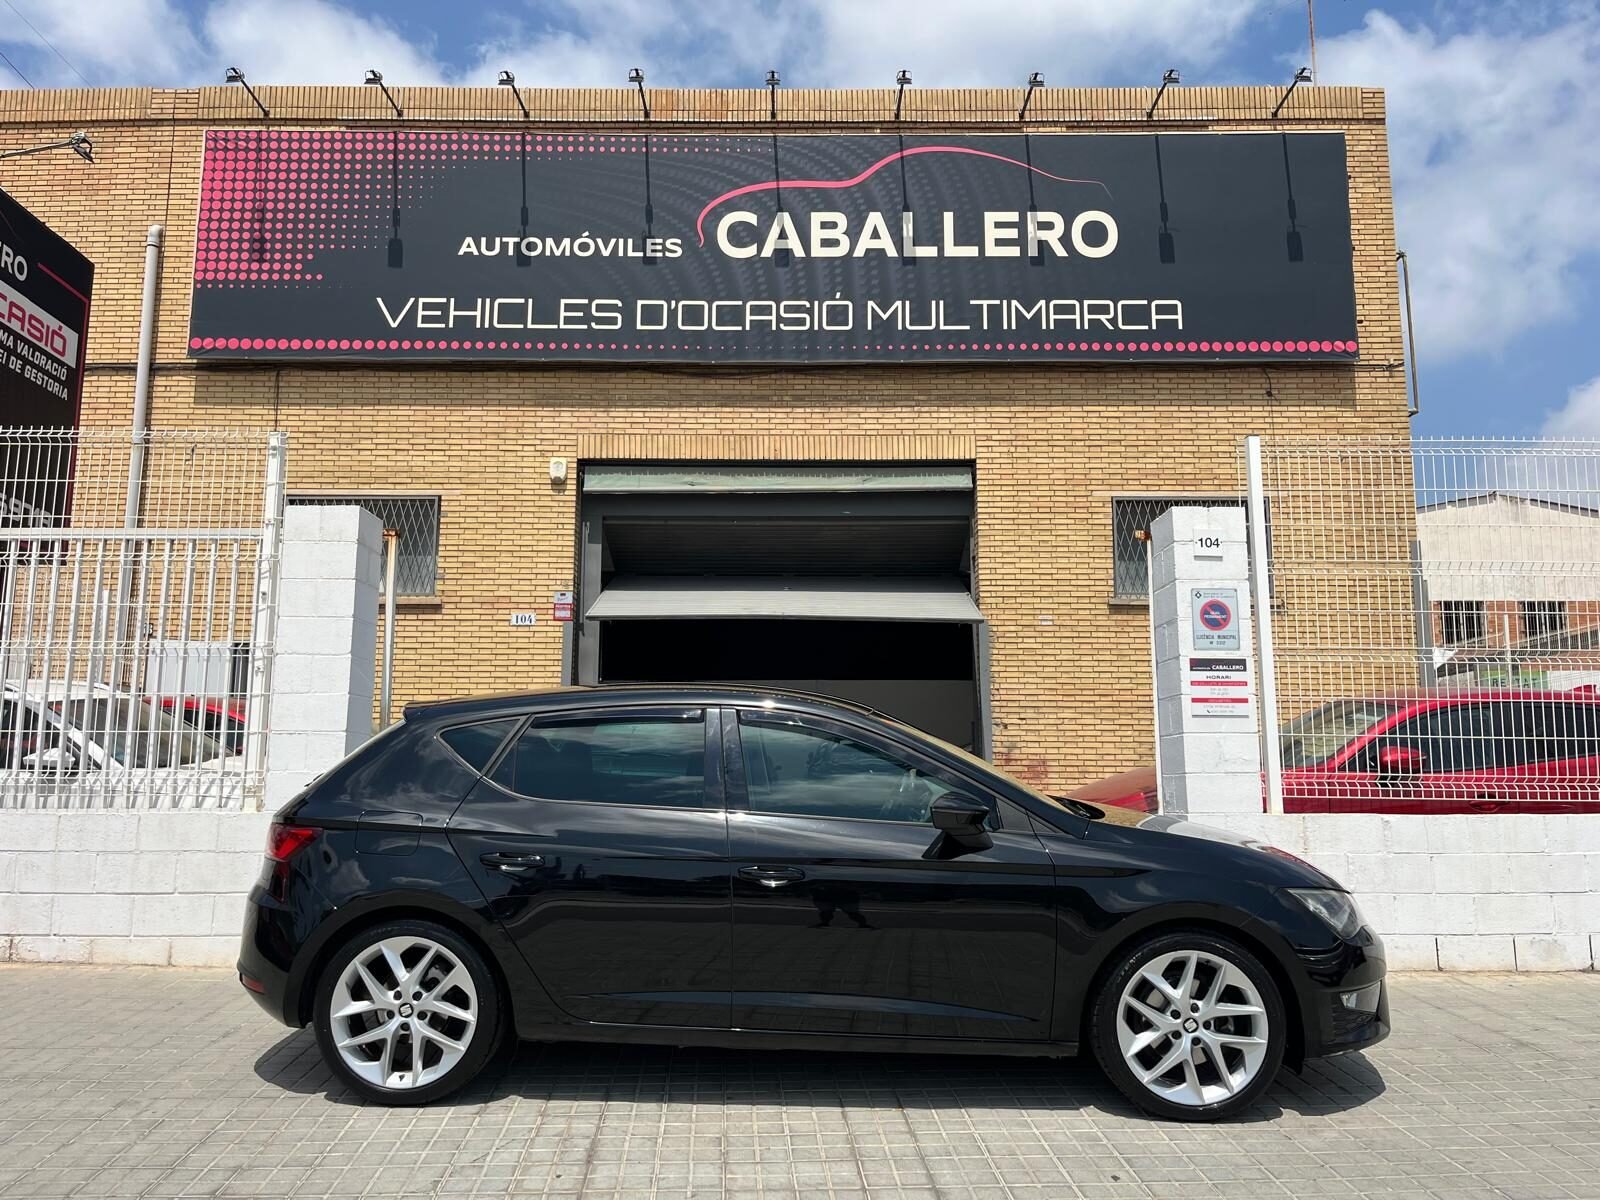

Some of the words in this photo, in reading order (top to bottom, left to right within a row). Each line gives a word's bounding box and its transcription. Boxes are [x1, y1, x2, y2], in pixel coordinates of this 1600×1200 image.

[457, 231, 683, 259] AUTOMÓVILES
[716, 210, 1119, 259] CABALLERO
[0, 241, 28, 281] RO
[376, 297, 623, 330] VEHICLES
[636, 292, 854, 331] D'OCASIÓ
[867, 299, 1184, 331] MULTIMARCA
[8, 355, 23, 374] DE
[24, 365, 68, 401] GESTORIA
[17, 340, 67, 381] VALORACIÓ
[1198, 537, 1221, 549] 104
[515, 614, 533, 625] 104
